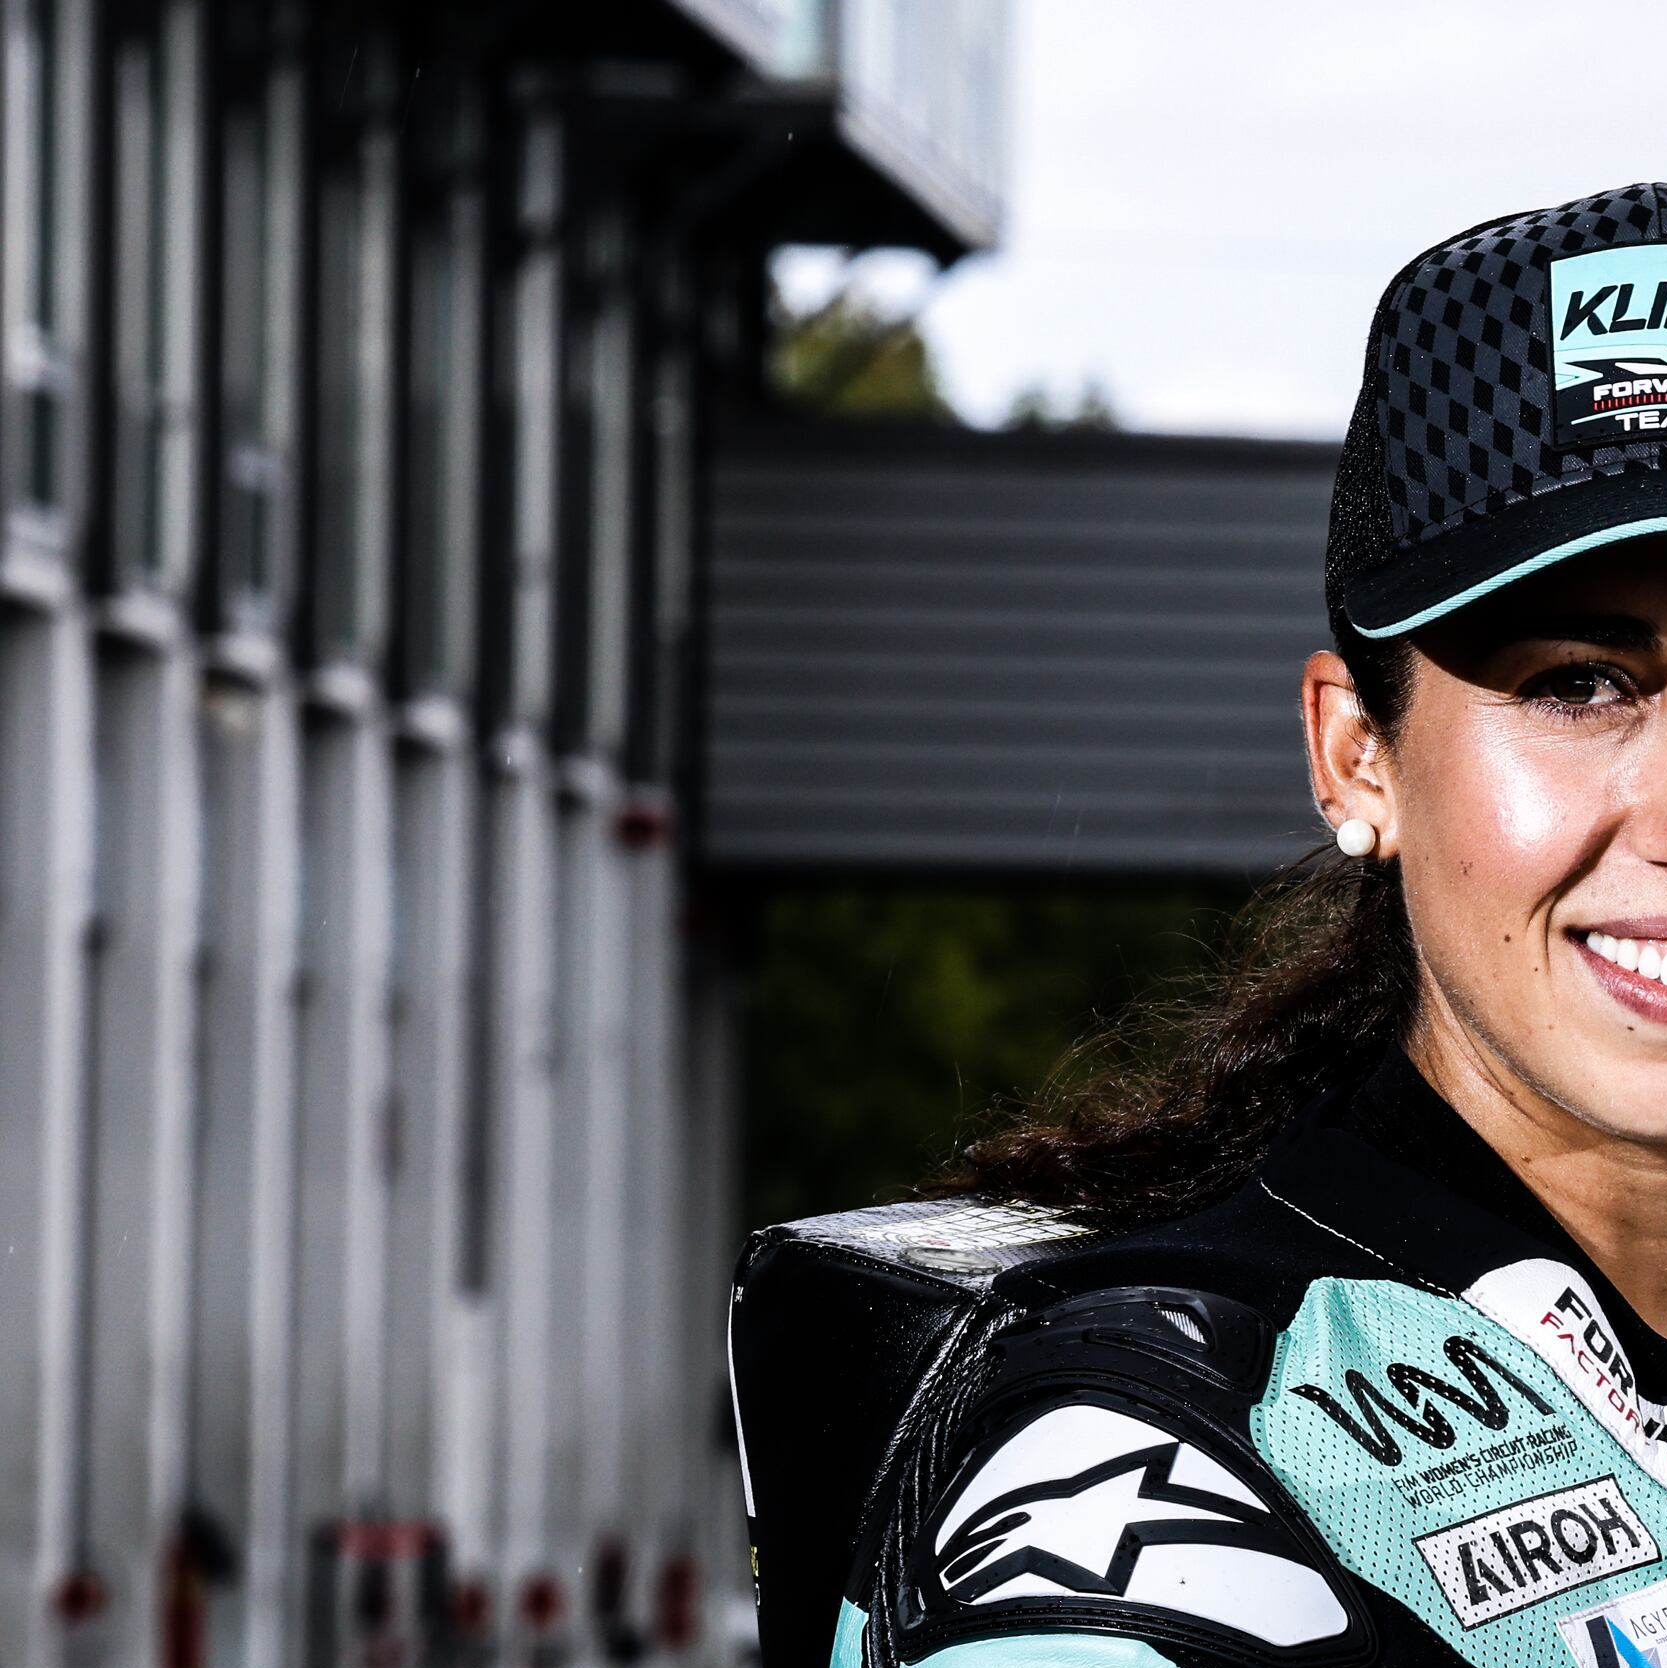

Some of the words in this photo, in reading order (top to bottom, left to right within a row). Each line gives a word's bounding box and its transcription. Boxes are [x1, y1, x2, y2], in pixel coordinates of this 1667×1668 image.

[1540, 1311, 1642, 1434] FACTOR
[1403, 1478, 1464, 1509] WORLD
[1465, 1439, 1578, 1488] CHAMPIONSHIP
[1419, 1452, 1481, 1485] WOMEN'S
[1461, 1497, 1641, 1606] AIROH
